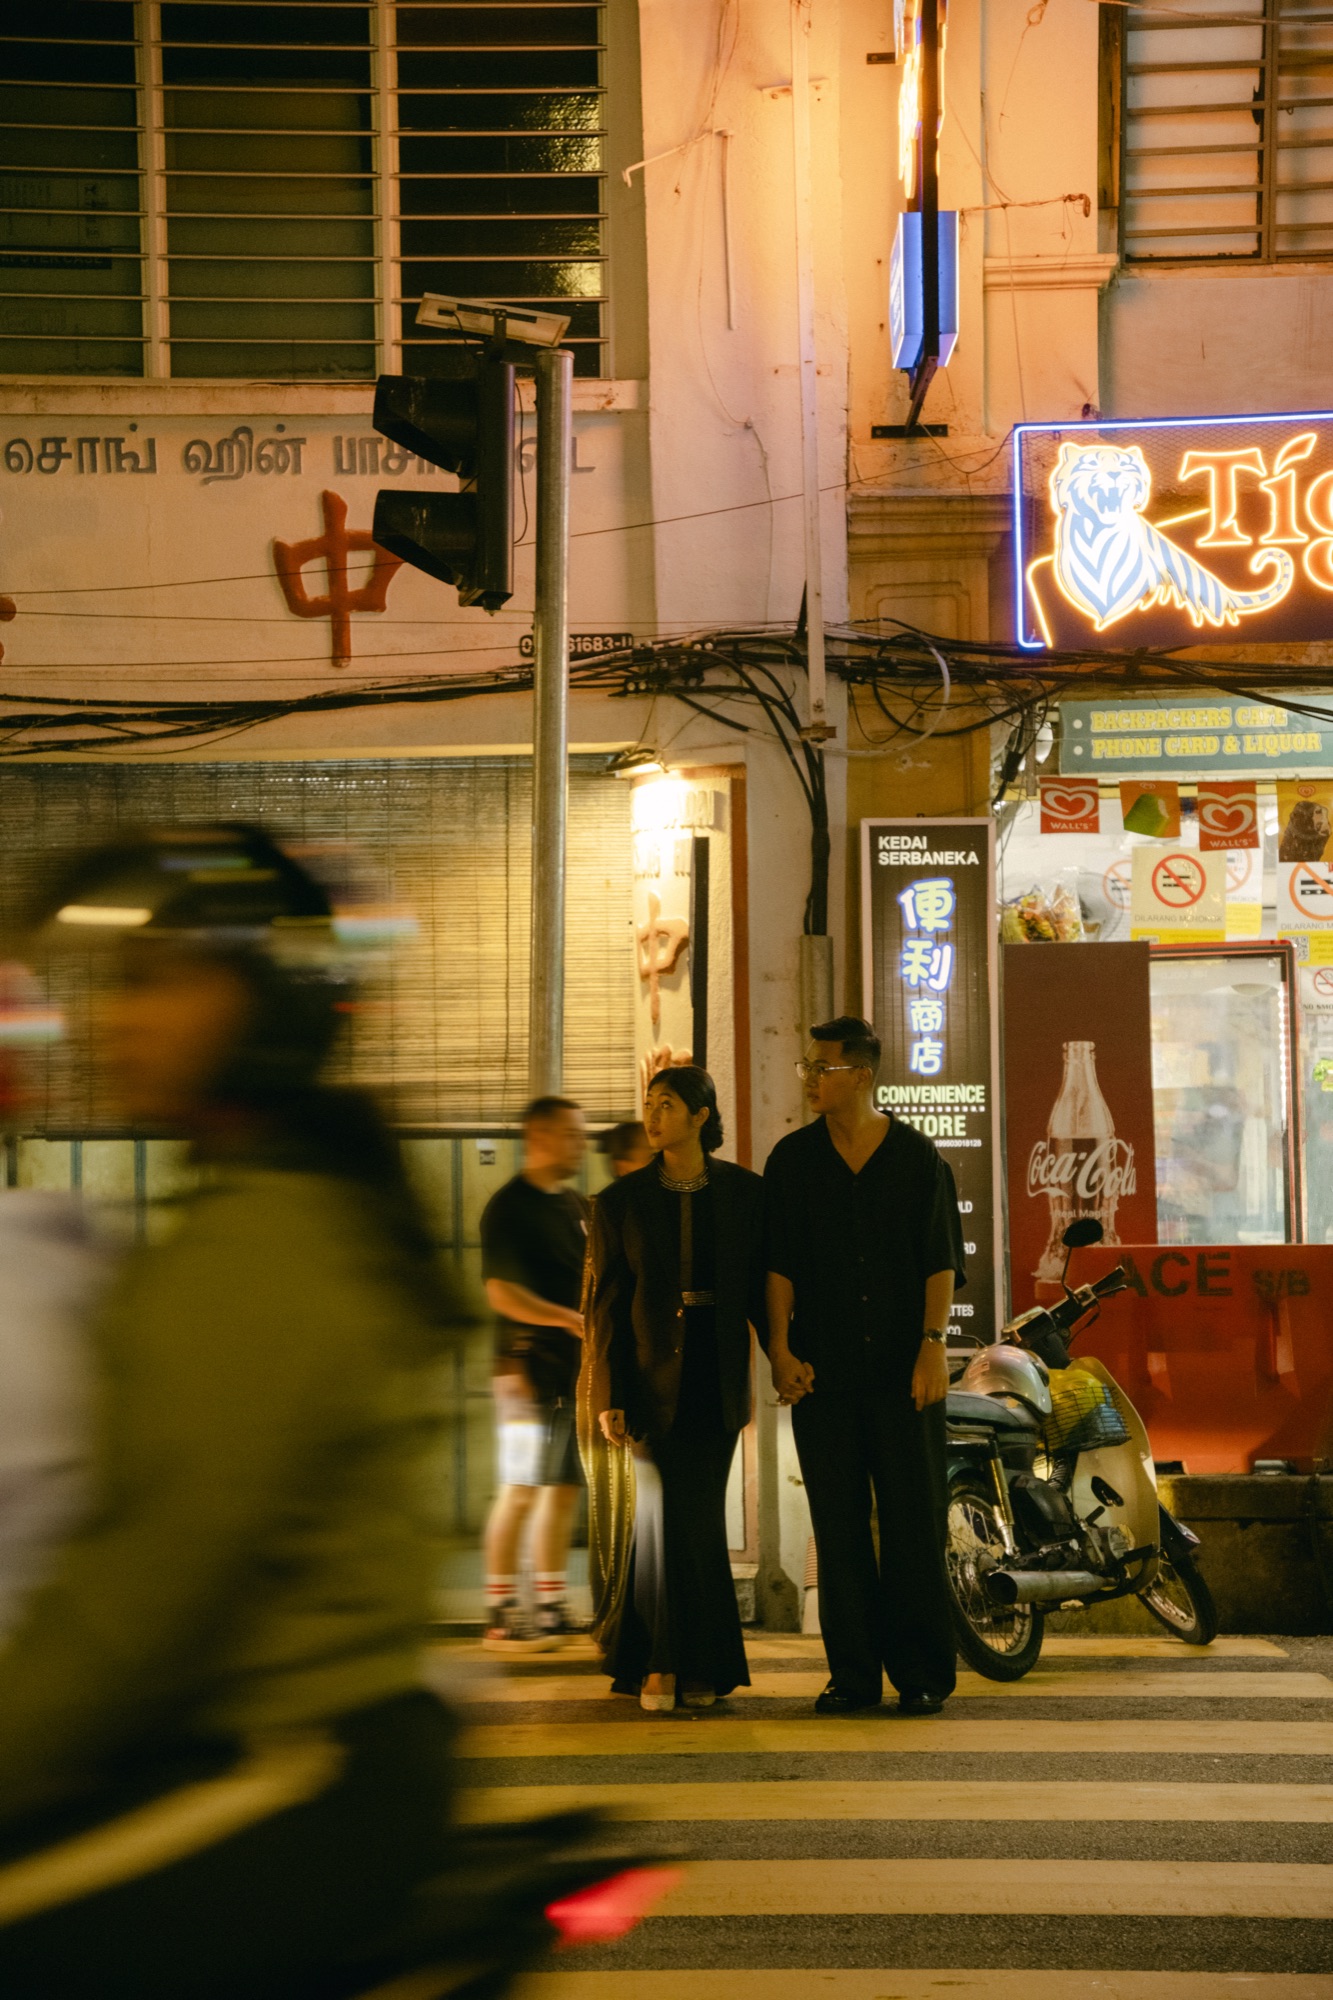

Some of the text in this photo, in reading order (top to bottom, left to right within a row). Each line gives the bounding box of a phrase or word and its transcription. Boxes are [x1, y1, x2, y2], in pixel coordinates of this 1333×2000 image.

[273, 489, 405, 668] 中
[1091, 706, 1288, 732] BACKPACKERS CAFE
[1092, 732, 1322, 758] PHONE CARD & LIQUOR
[1050, 822, 1089, 830] WALL'S
[878, 836, 928, 850] KEDAI
[1209, 839, 1249, 848] WALL'S
[878, 851, 980, 865] SERBANEKA
[1134, 914, 1177, 923] DILARANG
[1281, 922, 1325, 930] DILARANG
[899, 878, 955, 1075] 便利商店
[877, 1085, 985, 1104] CONVENIENCE
[1027, 1139, 1136, 1199] Coca-Cola
